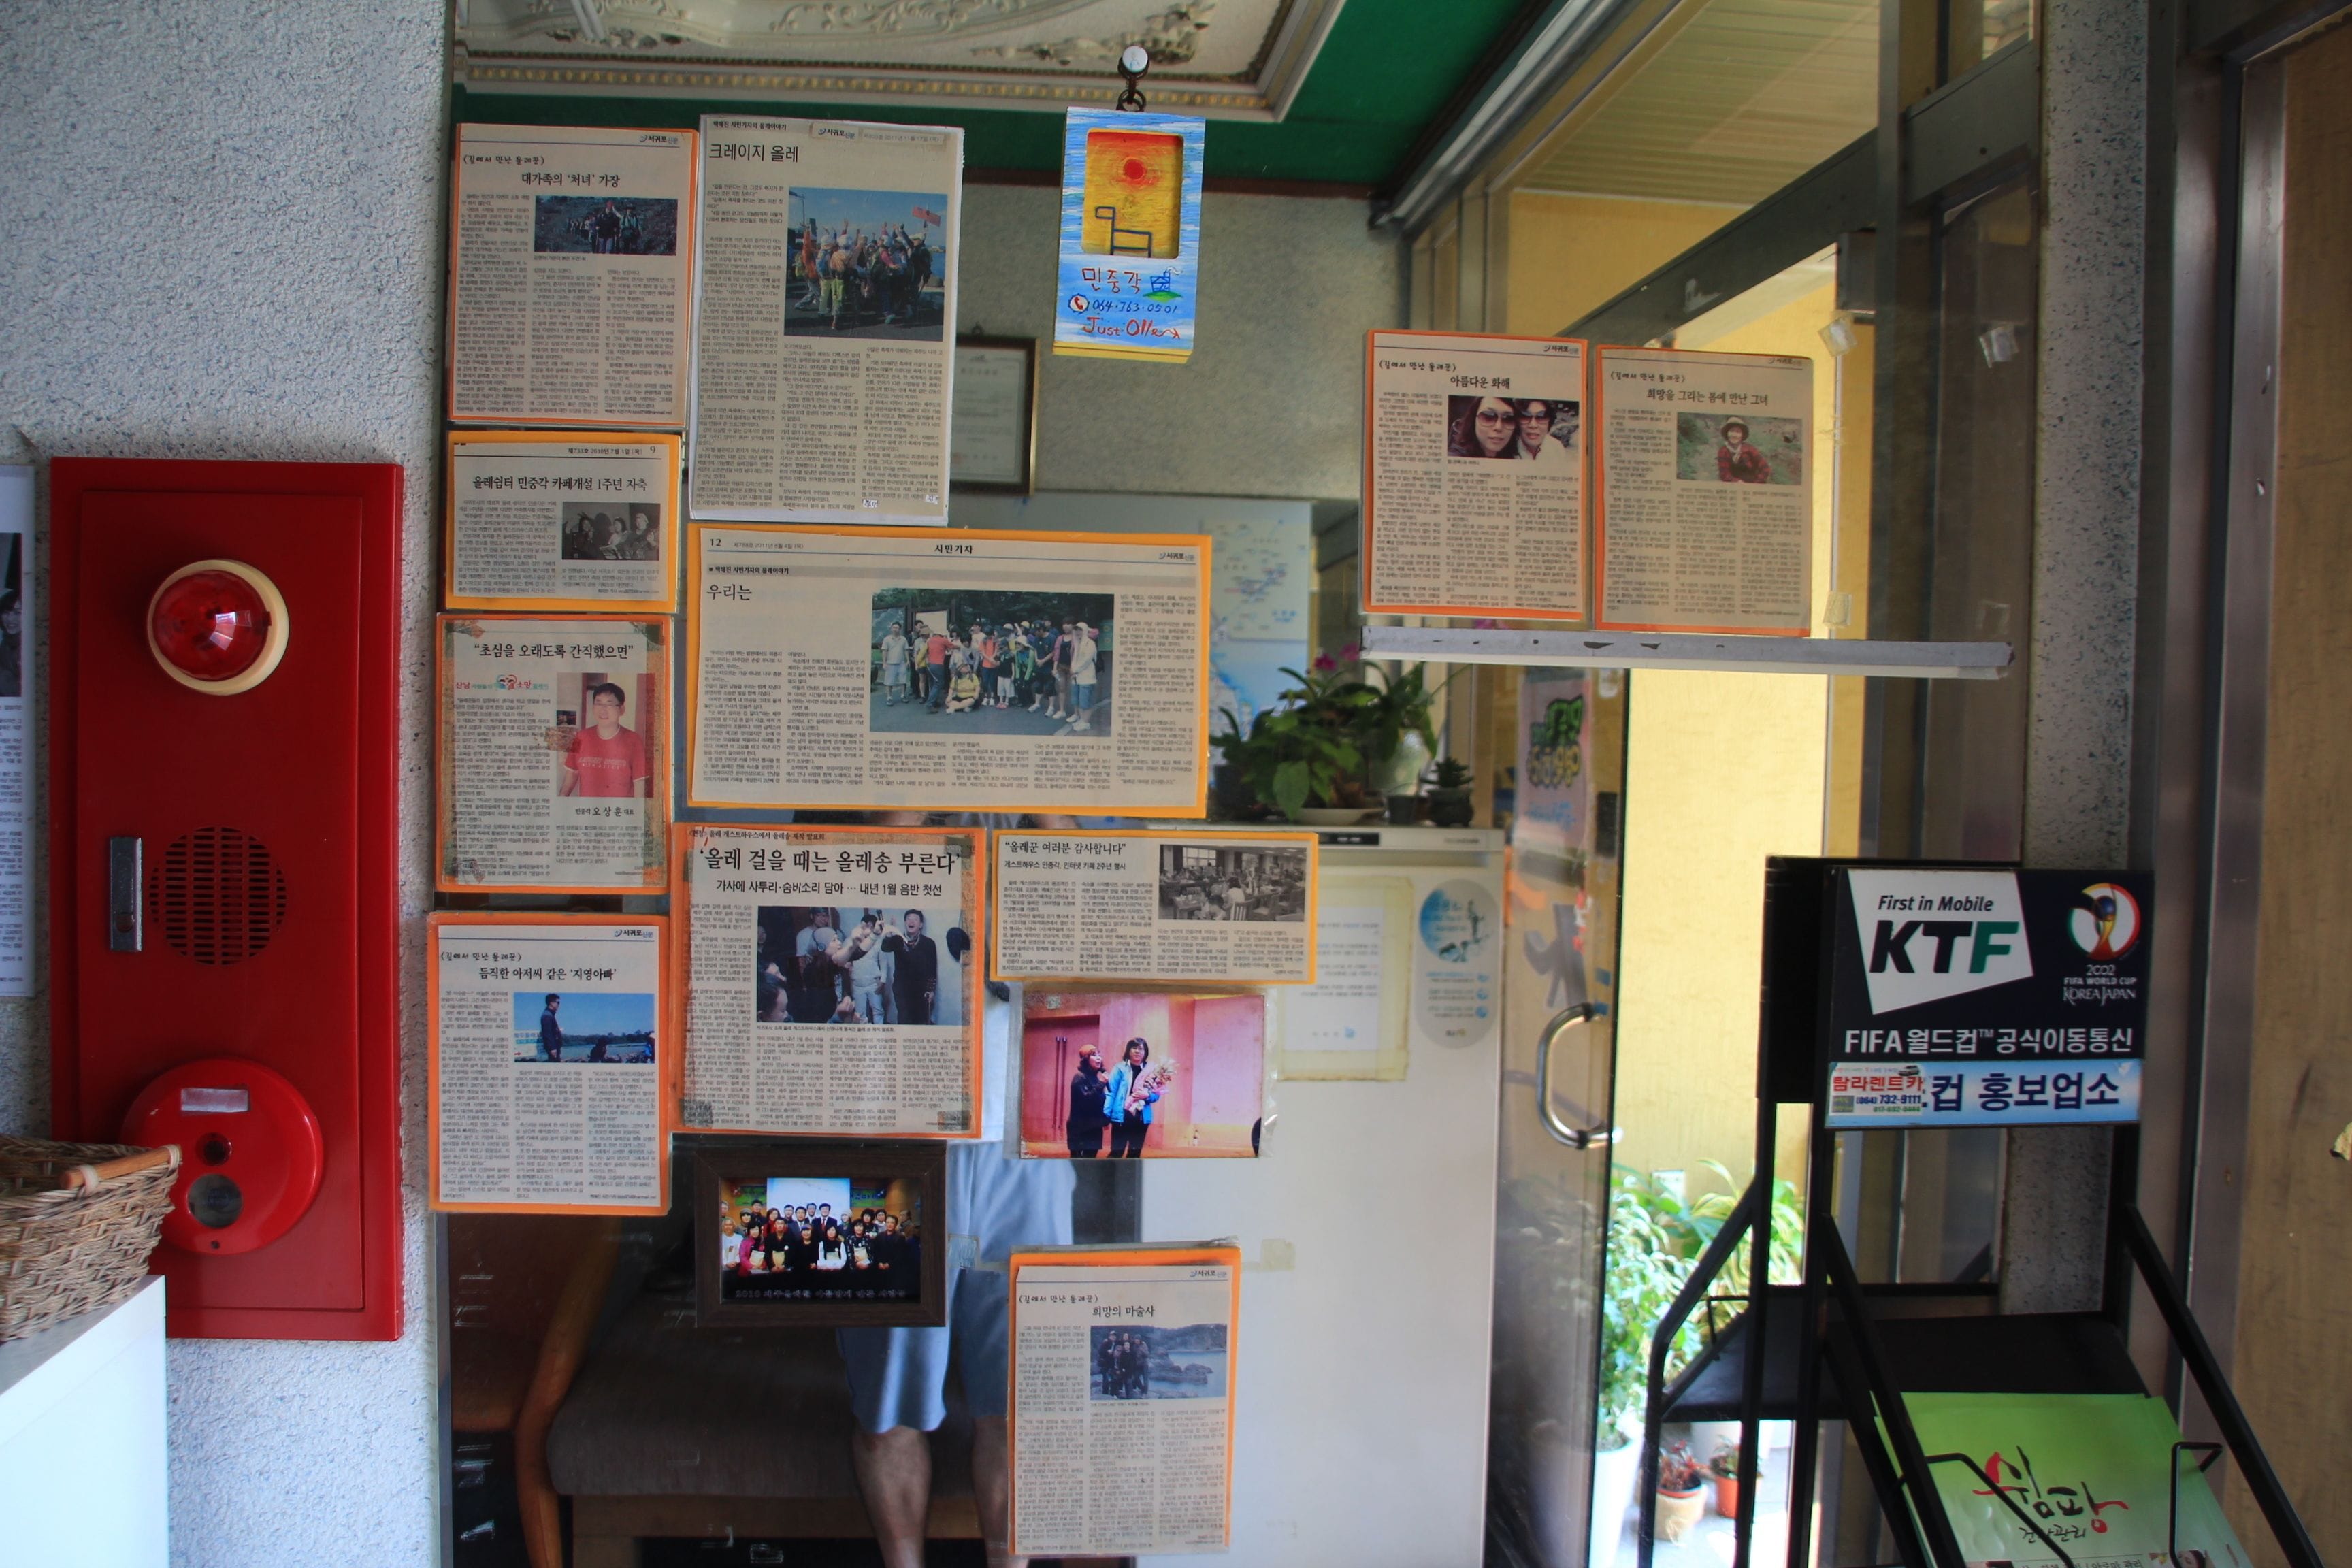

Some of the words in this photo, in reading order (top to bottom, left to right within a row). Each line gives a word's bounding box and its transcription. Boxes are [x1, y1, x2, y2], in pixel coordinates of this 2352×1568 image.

[495, 156, 512, 164] 만난
[708, 144, 764, 161] 크레이지
[771, 145, 799, 163] 올레
[522, 173, 563, 186] 대가족의
[599, 174, 620, 188] 가장
[1082, 267, 1142, 294] 민중각
[1083, 316, 1120, 336] Just
[1409, 362, 1425, 370] 만난
[1450, 376, 1488, 388] 아름다운
[1491, 377, 1510, 389] 화해
[1647, 388, 1674, 401] 희망을
[1678, 390, 1704, 402] 그리는
[1729, 393, 1747, 404] 만난
[1750, 393, 1768, 406] 그녀
[473, 476, 513, 489] 올레쉼터
[518, 477, 549, 489] 민중각
[552, 478, 593, 490] 카페개설
[598, 478, 622, 490] 1주년
[627, 478, 647, 491] 자축
[710, 538, 721, 546] 12
[934, 544, 973, 554] 시민기자
[707, 584, 752, 600] 우리는
[519, 644, 566, 658] 오래도록
[773, 832, 791, 840] 올레송
[1042, 843, 1071, 854] 여러분
[748, 849, 786, 871] 걸을
[794, 851, 829, 872] 때는
[836, 851, 892, 873] 올레송
[1004, 860, 1040, 869] 게스트하우스
[1064, 862, 1081, 870] 인터넷
[1083, 862, 1095, 870] 카페
[1096, 862, 1112, 870] 2주년
[717, 879, 745, 893] 가사에
[824, 882, 843, 894] 담아
[860, 883, 879, 895] 내년
[883, 883, 896, 896] 1월
[900, 884, 919, 896] 음반
[923, 884, 942, 896] 첫선
[1878, 895, 1914, 911] First
[1918, 896, 1933, 911] in
[1938, 896, 1994, 912] Mobile
[1869, 920, 2020, 973] KTF
[478, 967, 509, 980] 듬직한
[512, 968, 542, 980] 아저씨
[546, 968, 566, 980] 같은
[2086, 964, 2117, 975] 2002
[2063, 987, 2100, 1005] KOREA
[2101, 987, 2136, 1006] JAPAN
[1844, 1030, 1903, 1054] FIFA
[1997, 1028, 2132, 1054] 공식이동통신
[1833, 1076, 1923, 1092] 탐라렌트카
[1922, 1073, 1963, 1111] 컵
[1979, 1071, 2119, 1111] 홍보업소
[1880, 1094, 1921, 1104] 732-9111
[1092, 1306, 1121, 1318] 희망의
[1126, 1306, 1155, 1318] 마술사
